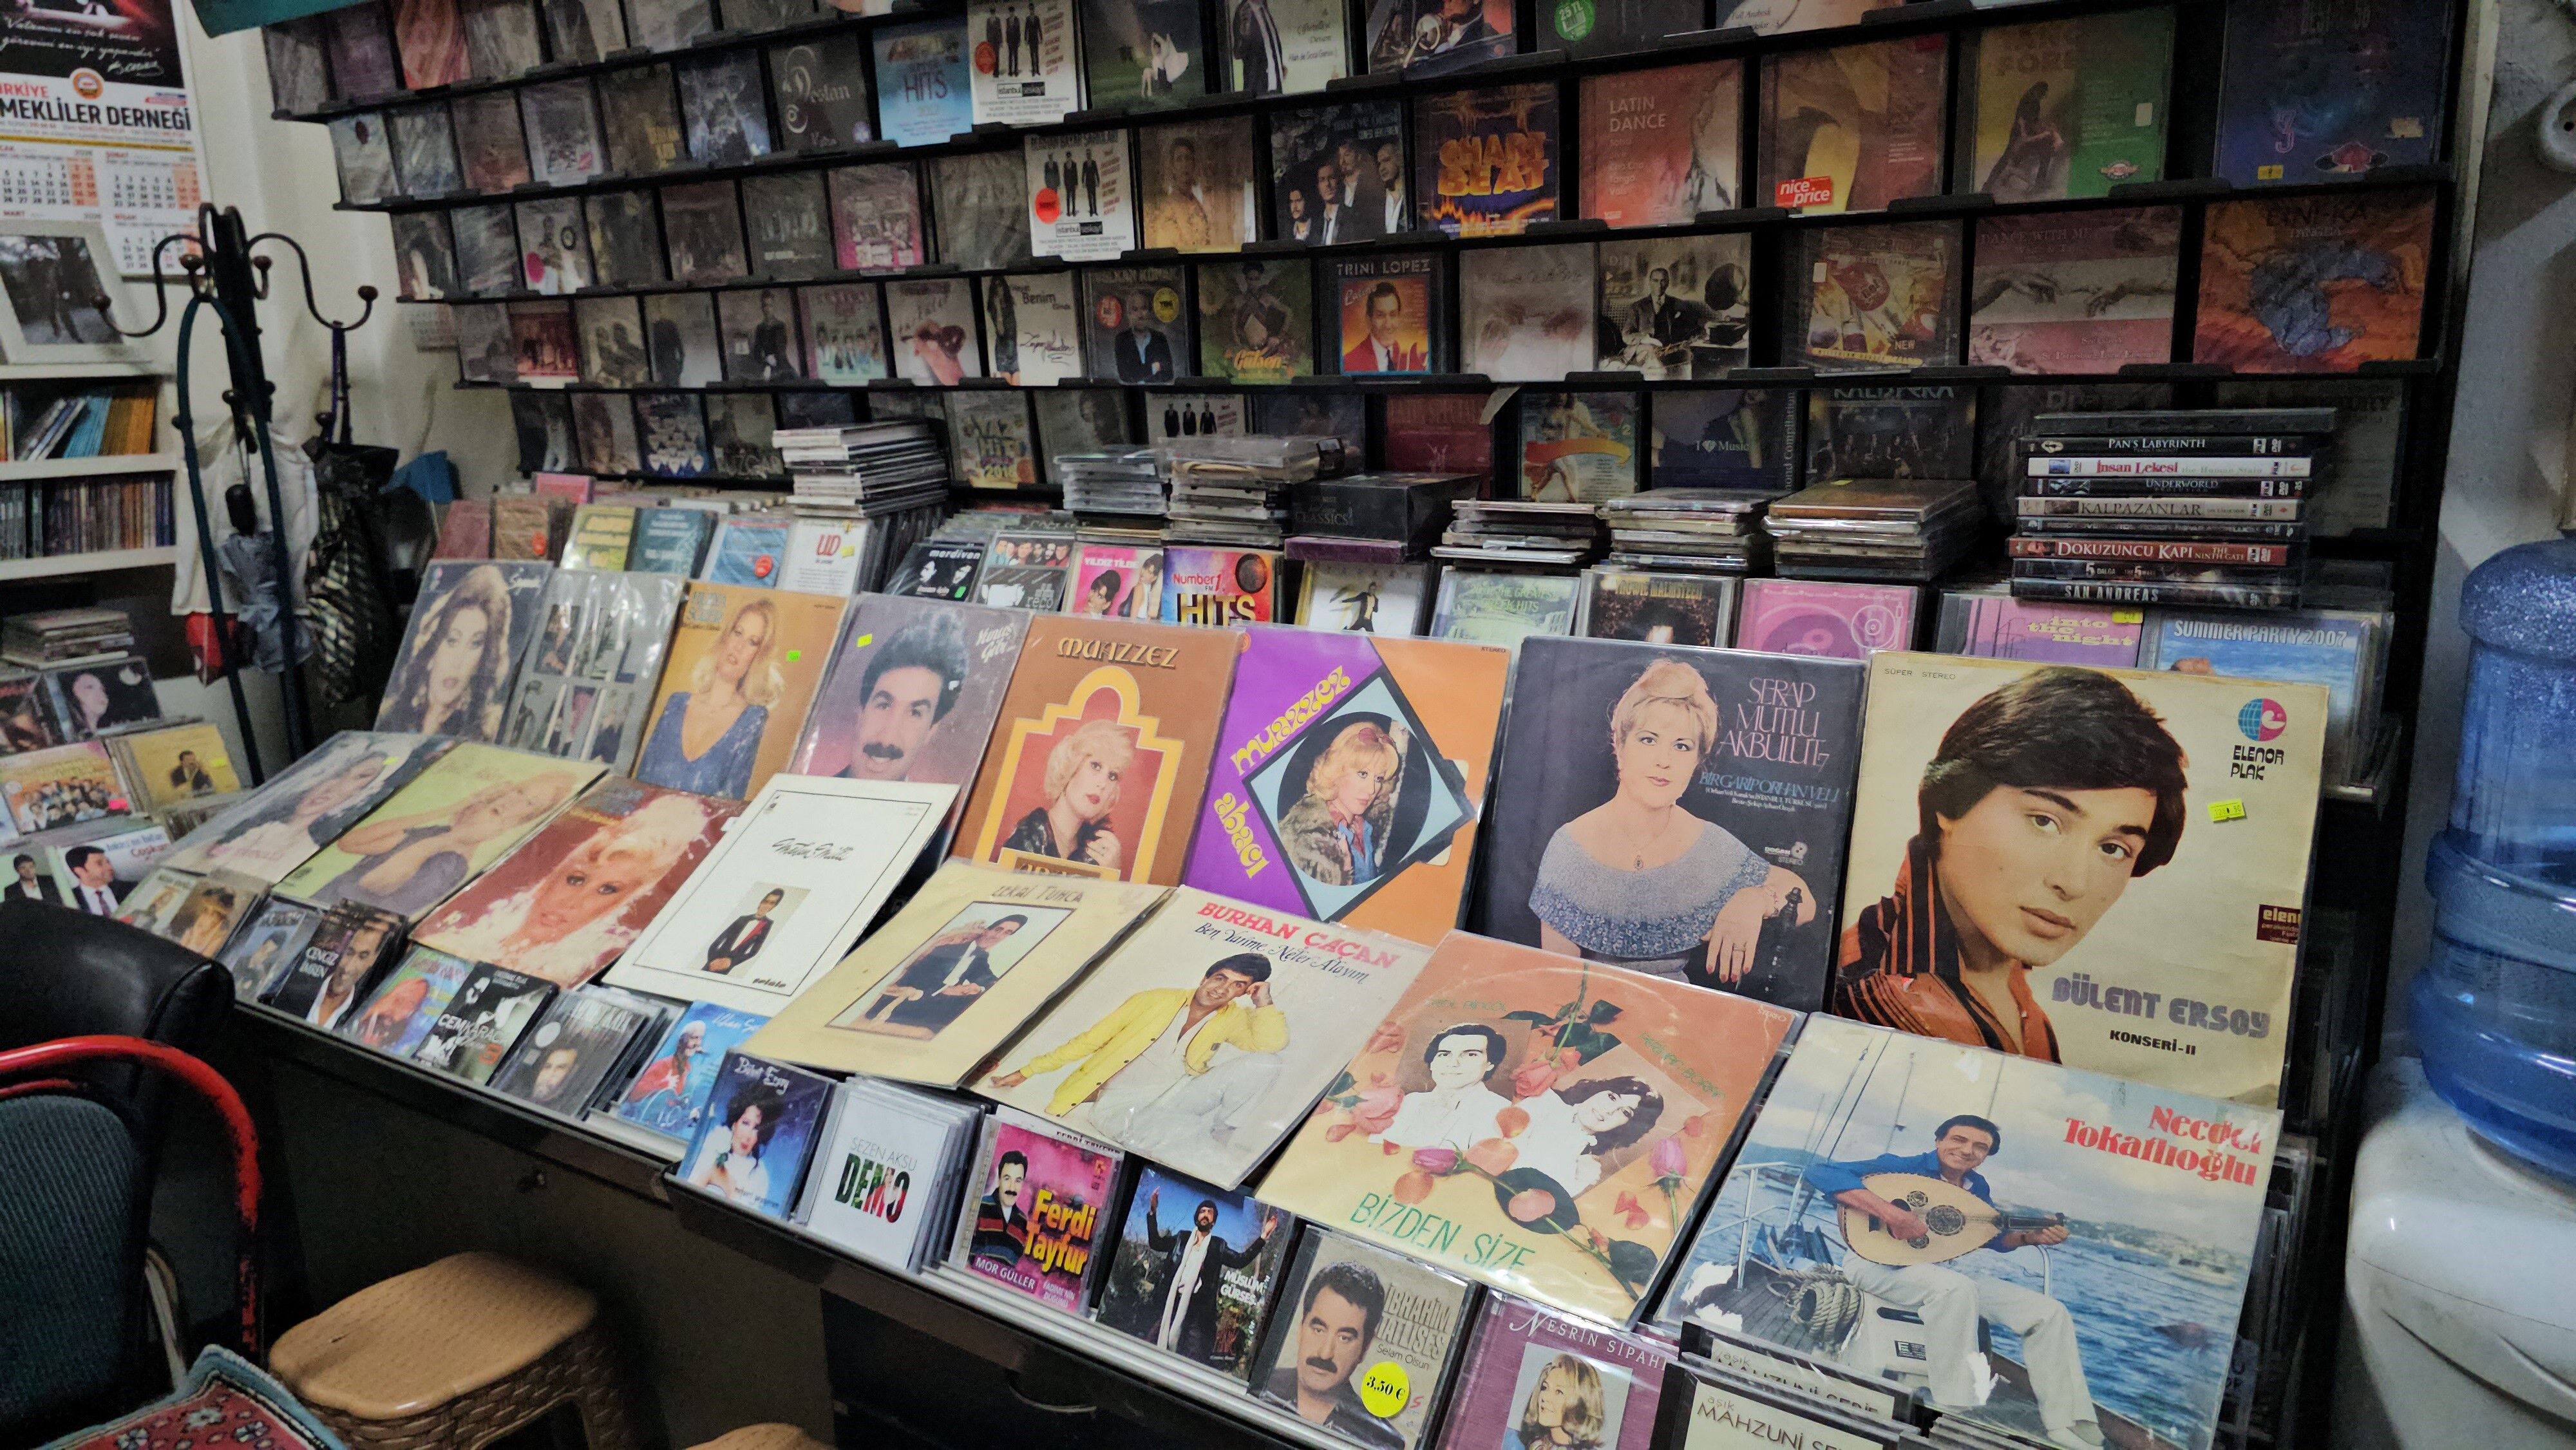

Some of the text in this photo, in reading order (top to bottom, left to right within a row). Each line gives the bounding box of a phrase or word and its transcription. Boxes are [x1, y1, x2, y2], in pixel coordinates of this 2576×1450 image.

[1609, 95, 1656, 115] LATIN
[106, 106, 192, 131] DERNEĞİ
[1609, 113, 1667, 133] DANCE
[1439, 131, 1546, 170] CHART
[1437, 155, 1549, 197] BEAT
[1779, 179, 1810, 196] nice
[1792, 187, 1832, 207] price
[1336, 259, 1432, 276] TRINI LOPEZ
[1894, 339, 1916, 351] NEW
[1718, 440, 1750, 452] Music
[2108, 438, 2206, 449] PAN'S LABYRINTH
[2145, 478, 2219, 489] UNDERWORLD
[2081, 503, 2202, 516] KALPAZANLAR
[2058, 541, 2154, 557] DOKUZUNCU
[2158, 544, 2193, 560] KAPI
[2085, 562, 2096, 576] 5
[2065, 585, 2159, 603] SAN ANDREAS
[1177, 593, 1256, 626] HITS
[2026, 621, 2076, 634] the
[2049, 616, 2109, 628] into
[2173, 619, 2348, 648] SUMMER PARTY 2007
[1480, 645, 1507, 654] STEREO
[2051, 633, 2136, 647] night
[1056, 637, 1179, 670] MUAZZEZ
[1884, 668, 1956, 681] SUPER STEREO
[1746, 677, 1816, 709] SERAP
[1229, 664, 1352, 776] muazzez
[1736, 702, 1821, 739] MUTLU
[2232, 744, 2285, 766] ELENOR
[2230, 762, 2266, 781] PLAK
[1195, 921, 1222, 941] Ben
[1195, 901, 1401, 970] BURHAN ÇAÇAN
[2051, 972, 2271, 1039] BÜLENT ERSOY
[2108, 1030, 2196, 1056] KONSERİ-II
[850, 1135, 918, 1172] SEZEN AKSU
[834, 1152, 911, 1224] DEMO
[1033, 1187, 1098, 1241] Ferdi
[1349, 1191, 1537, 1272] BİZDEN SİZE
[1023, 1219, 1090, 1276] Tayfur
[975, 1256, 1037, 1291] MOR GÜLLER
[1224, 1270, 1266, 1294] MÜSLÜM
[1220, 1283, 1258, 1307] GÜRSES
[1384, 1283, 1452, 1334] İBRAHİM
[1508, 1308, 1598, 1348] NESRİN
[1377, 1343, 1430, 1371] Selam Olsun
[1366, 1375, 1406, 1402] 3.50 €
[1696, 1400, 1805, 1450] MAHZUNİ
